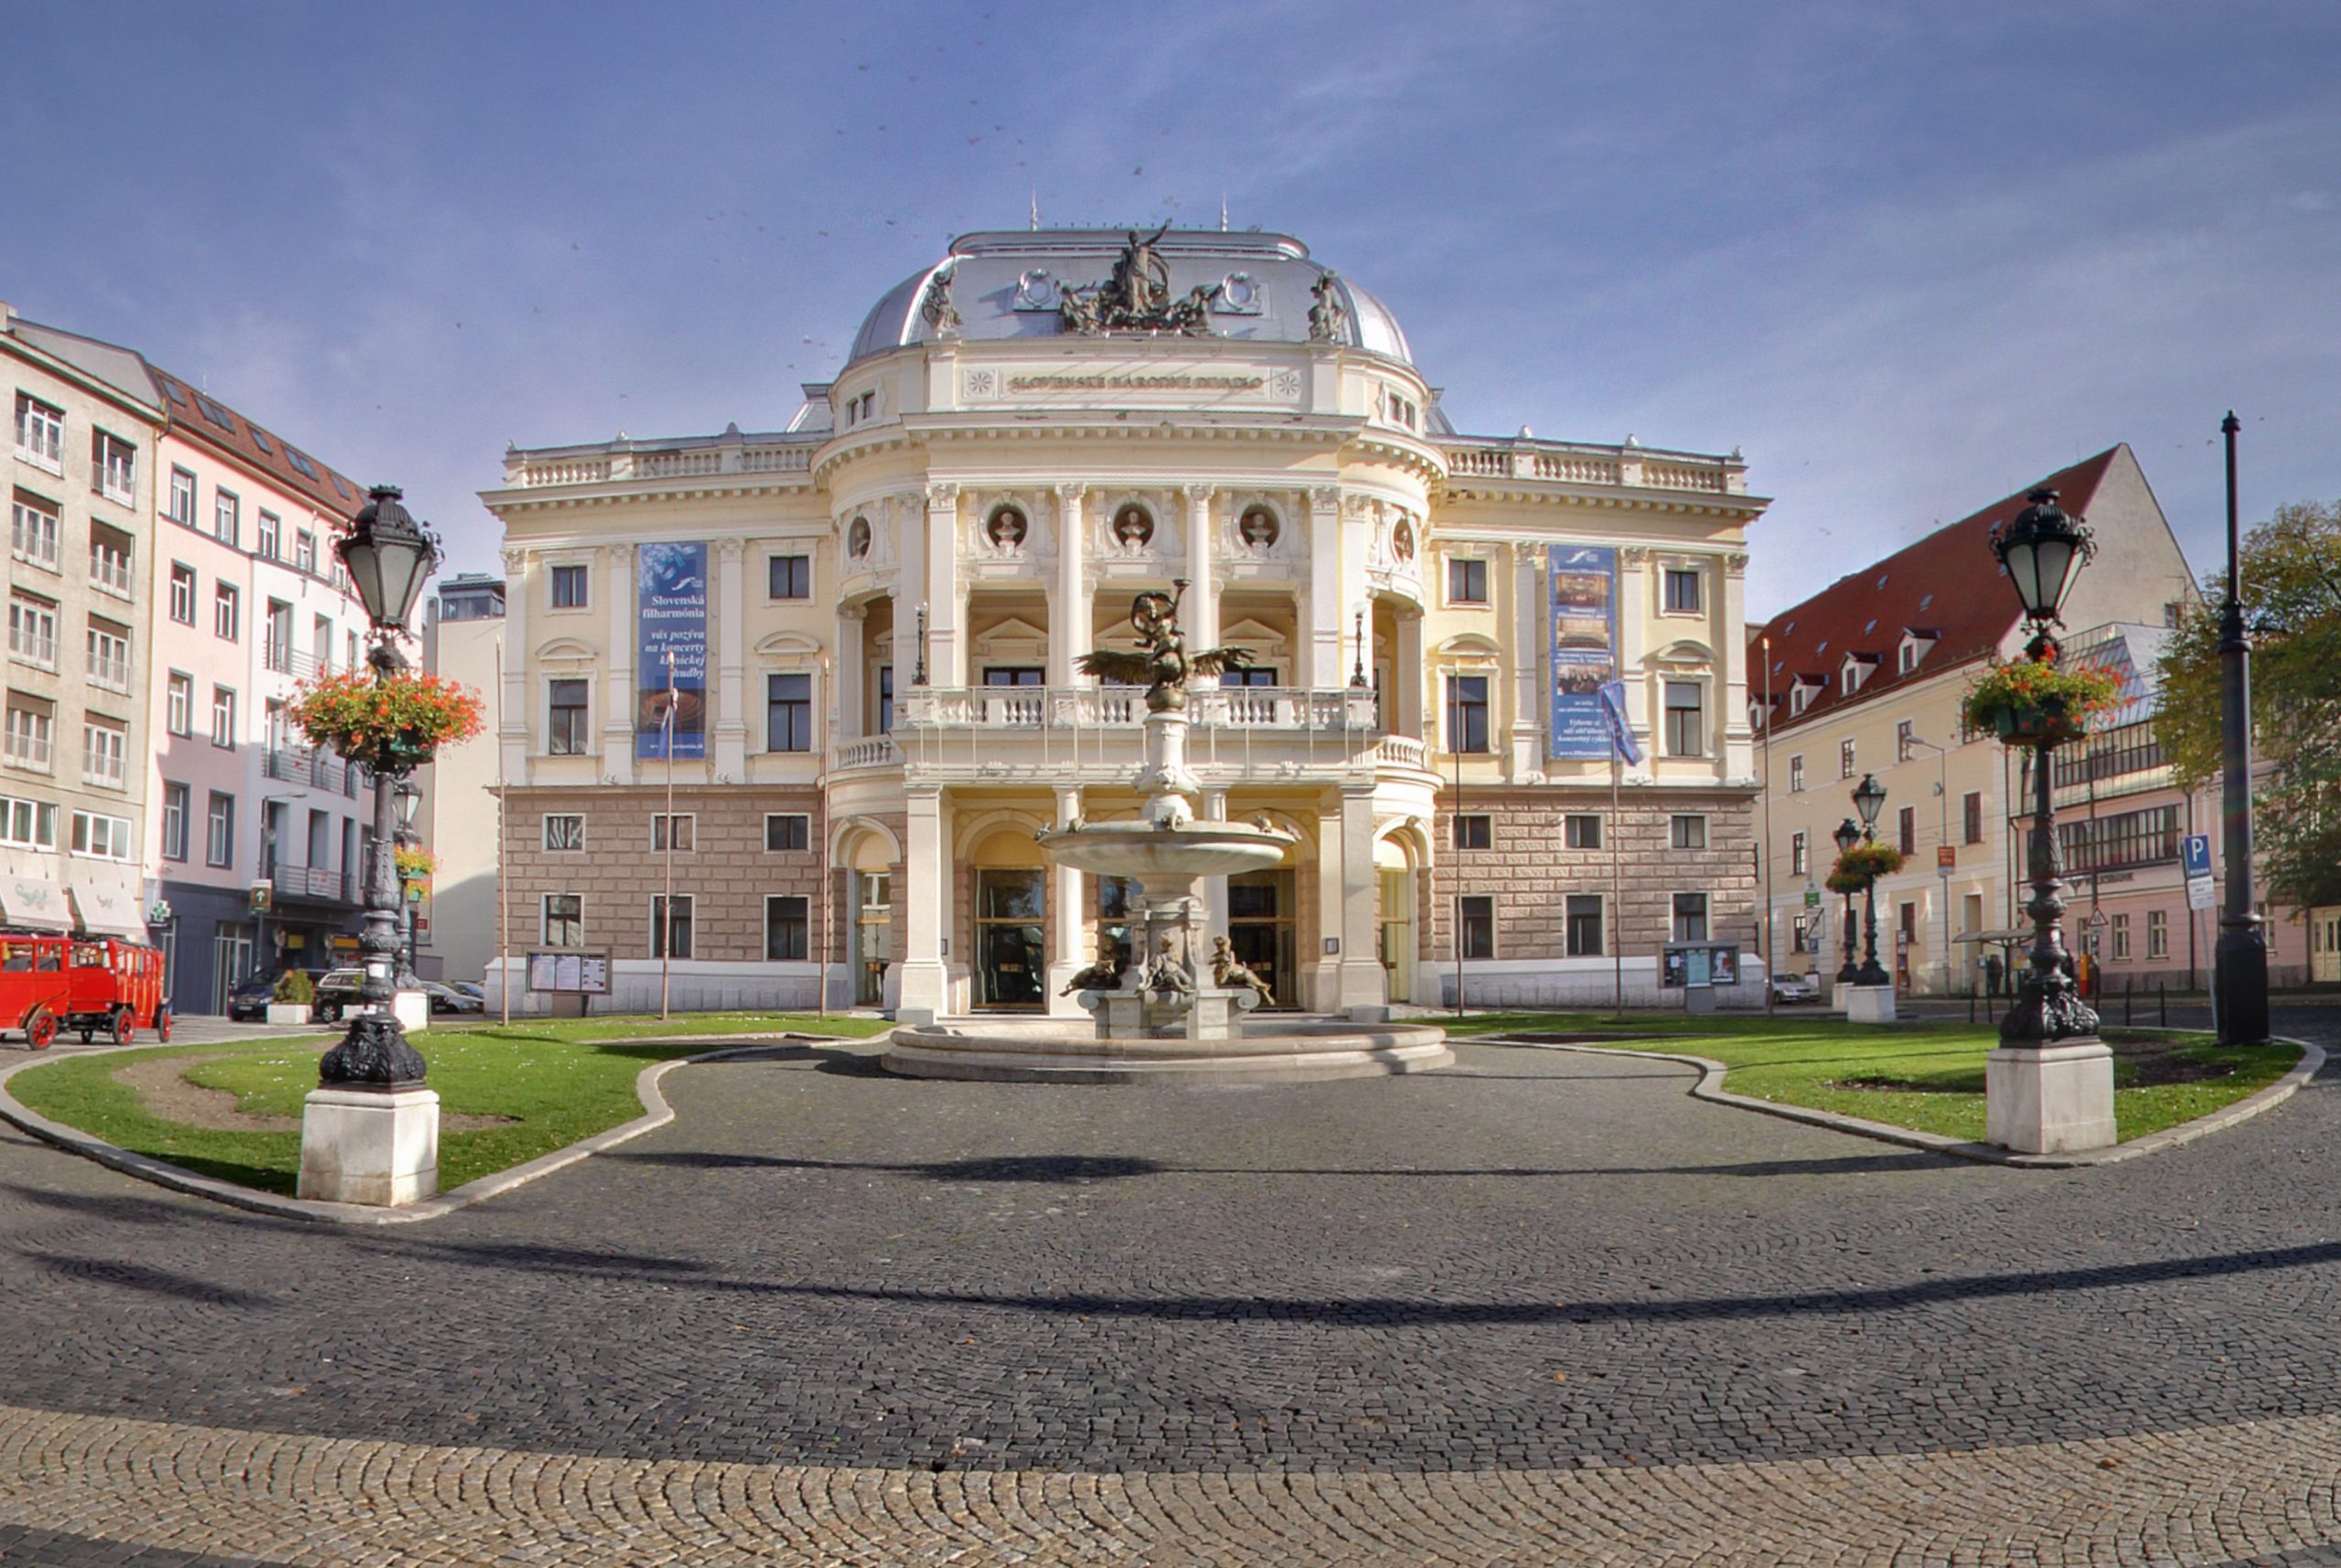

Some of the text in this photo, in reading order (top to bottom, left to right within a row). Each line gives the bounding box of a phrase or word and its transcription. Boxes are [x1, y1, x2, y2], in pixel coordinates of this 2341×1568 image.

[652, 594, 704, 606] Slovenská
[643, 607, 704, 618] filharmónia
[645, 642, 705, 654] na koncerty
[659, 655, 705, 667] klsickej
[2191, 837, 2204, 862] P
